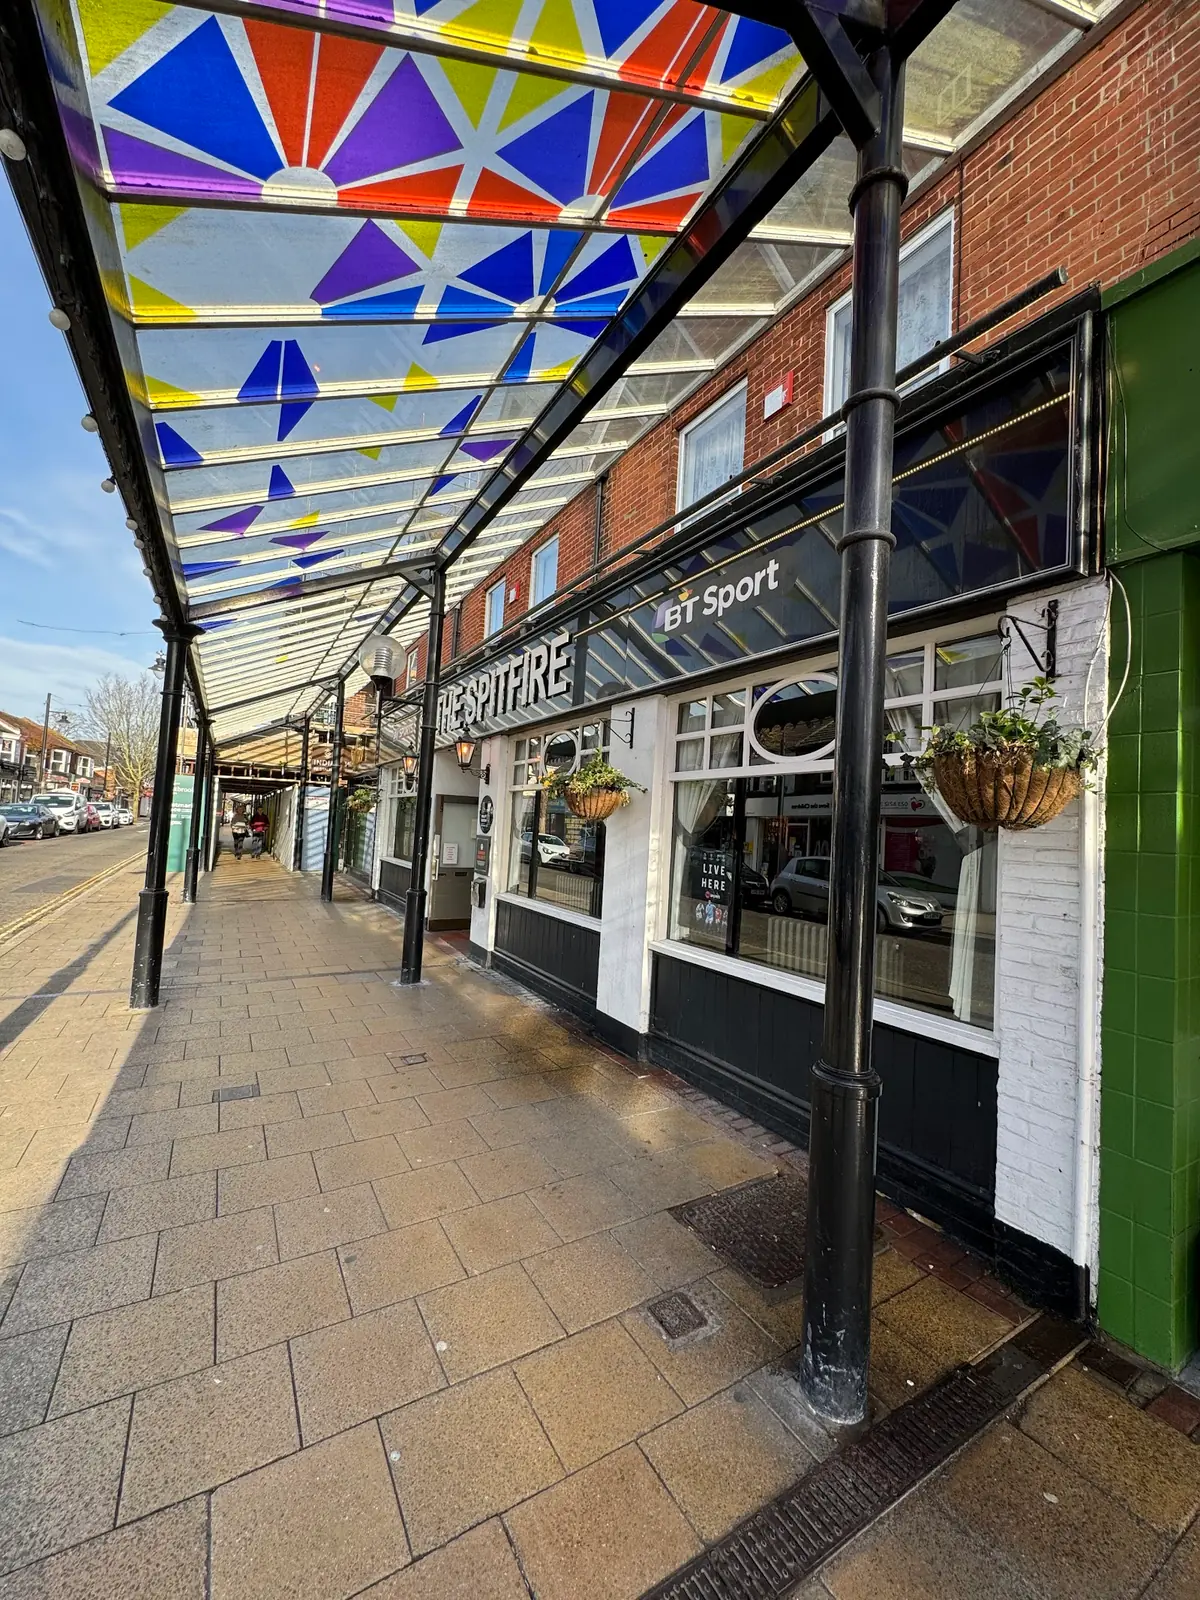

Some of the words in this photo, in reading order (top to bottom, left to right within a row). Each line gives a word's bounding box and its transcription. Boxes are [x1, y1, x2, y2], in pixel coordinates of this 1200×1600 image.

[664, 595, 700, 632] BT
[702, 558, 780, 617] Sport
[436, 685, 465, 735] THE
[464, 631, 572, 725] SPITFIRE
[701, 877, 726, 891] HERE
[702, 863, 726, 876] LIVE
